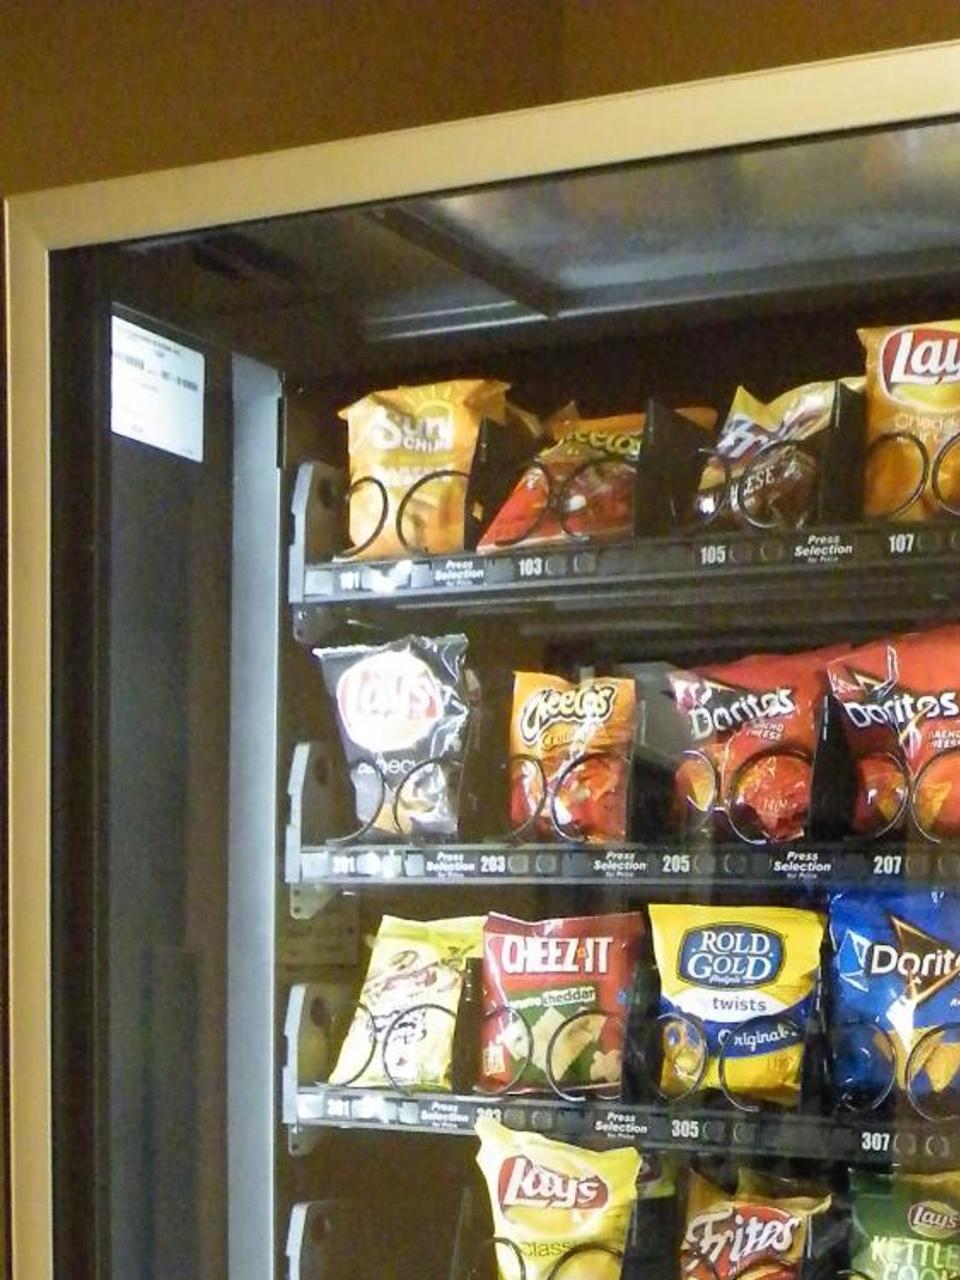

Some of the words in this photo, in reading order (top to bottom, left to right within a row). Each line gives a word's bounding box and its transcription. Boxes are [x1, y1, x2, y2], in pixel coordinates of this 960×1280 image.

[806, 534, 841, 546] Press
[888, 534, 915, 554] 107
[700, 545, 727, 565] 105
[793, 543, 854, 558] Selection
[518, 558, 544, 577] 103
[689, 687, 795, 741] Doritos
[843, 691, 960, 730] Doritos
[436, 851, 465, 863] Press
[605, 851, 635, 862] Press
[662, 855, 691, 875] 205
[786, 850, 819, 863] Press
[873, 855, 902, 875] 207
[426, 860, 476, 873] Selection
[592, 860, 647, 873] Selection
[773, 860, 832, 873] Selection
[700, 931, 771, 955] ROLD
[687, 952, 772, 980] GOLD
[712, 996, 767, 1012] twists
[430, 1101, 459, 1113] Press
[421, 1110, 470, 1123] Selection
[607, 1111, 636, 1124] Press
[594, 1120, 649, 1135] Selection
[671, 1119, 700, 1139] 305
[861, 1132, 891, 1152] 307
[685, 1206, 803, 1264] Fritos
[871, 1235, 960, 1271] KETTLE
